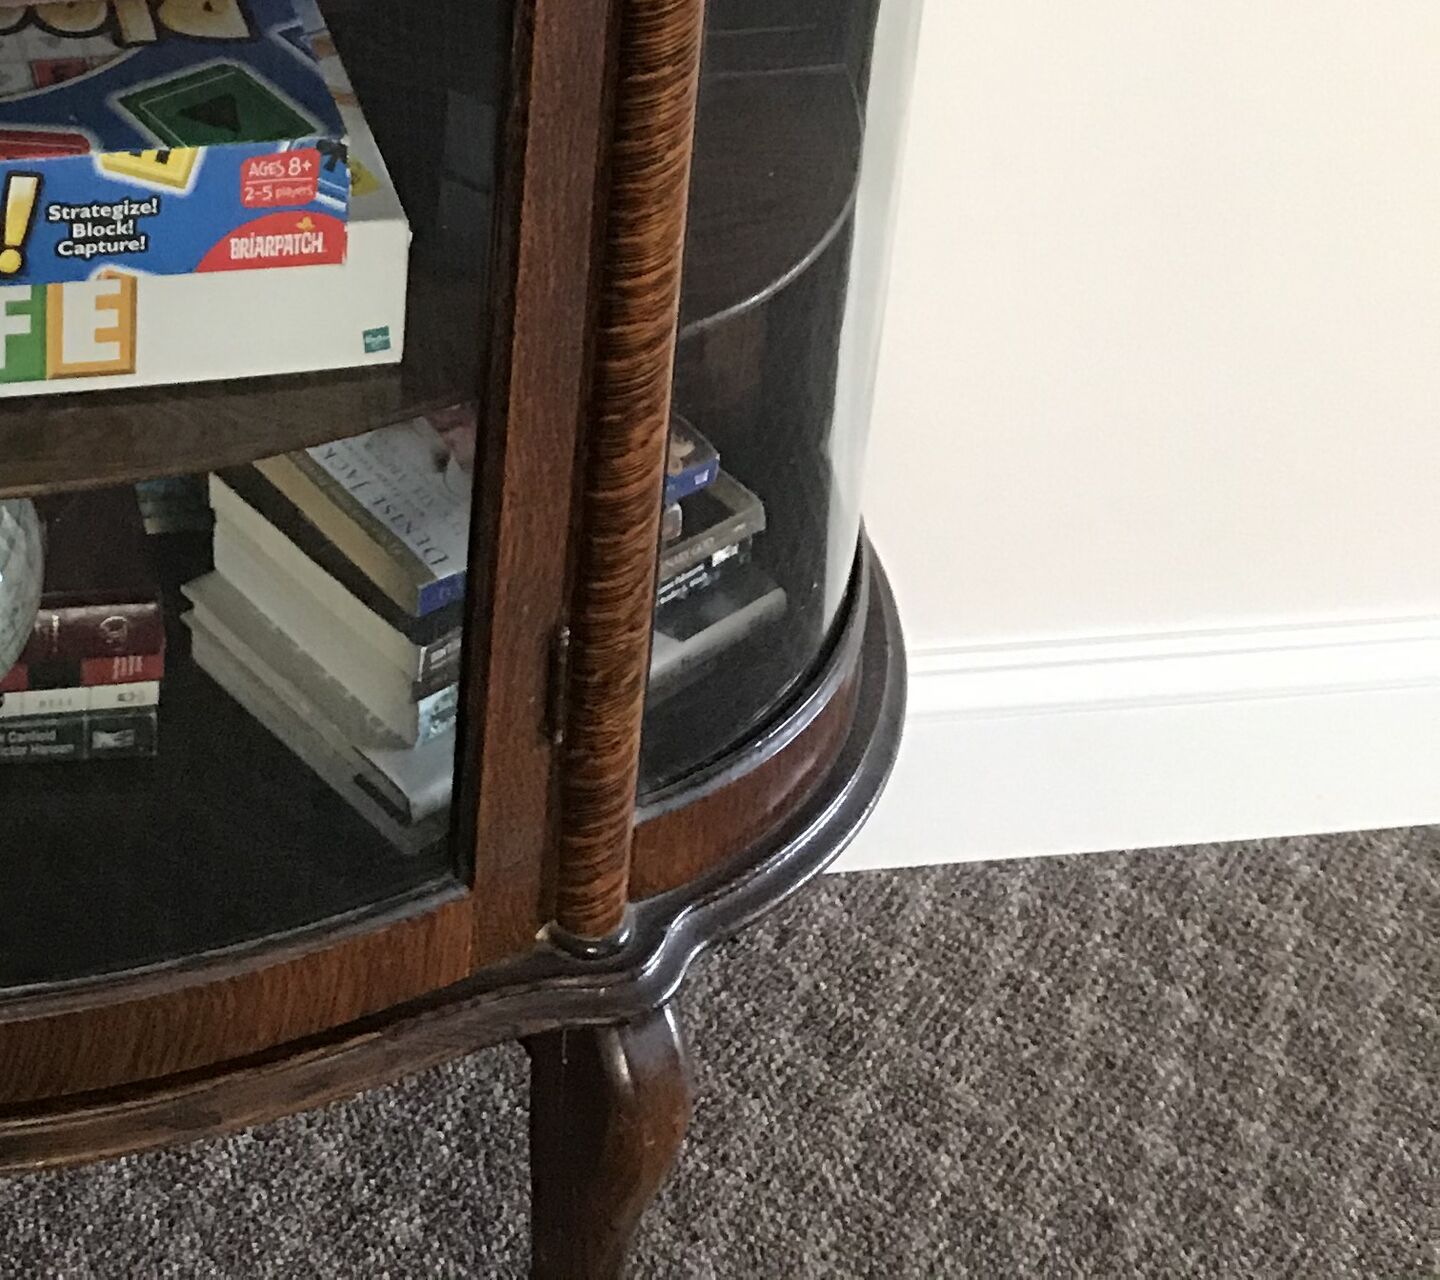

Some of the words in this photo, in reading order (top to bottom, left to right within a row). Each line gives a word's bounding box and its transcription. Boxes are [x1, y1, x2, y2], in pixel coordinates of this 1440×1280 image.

[247, 160, 286, 178] AGES
[287, 156, 313, 176] 8+
[244, 184, 274, 201] 2-5
[47, 198, 159, 222] Strategize!
[71, 220, 135, 239] Block!
[57, 236, 147, 259] Capture!
[229, 231, 324, 260] BRIARPATCH
